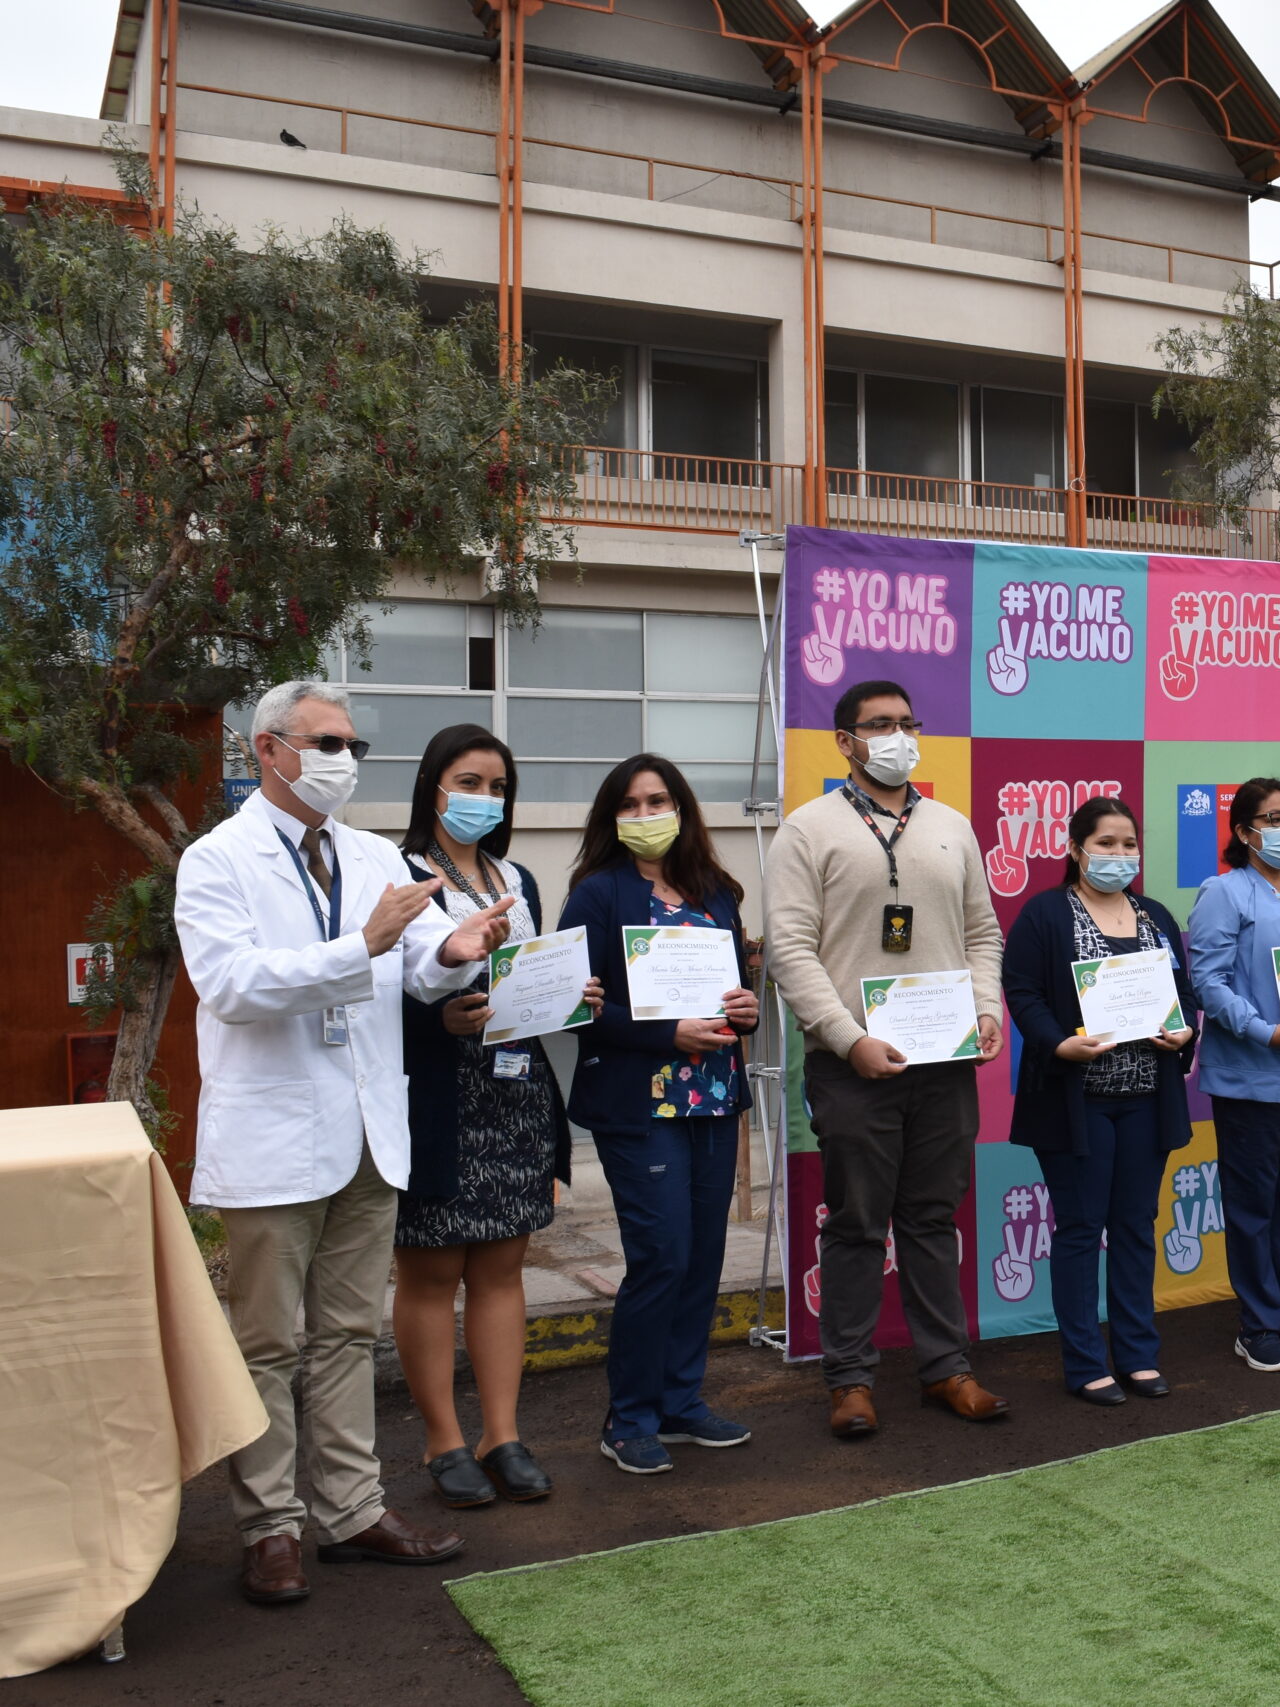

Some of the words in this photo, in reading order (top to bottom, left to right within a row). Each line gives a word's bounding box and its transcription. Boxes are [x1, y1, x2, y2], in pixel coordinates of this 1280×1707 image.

[816, 569, 889, 611] #YO
[899, 576, 949, 614] ME
[1002, 583, 1070, 621] #YO
[1078, 586, 1123, 624] ME
[1174, 594, 1234, 629] #YO
[814, 605, 955, 654] VACUNO
[1001, 619, 1132, 661] VACUNO
[1002, 784, 1068, 820] #YO
[518, 949, 574, 967] RECONOCIMIENTO
[657, 943, 718, 951] RECONOCIMIENTO
[1102, 967, 1155, 979] RECONOCIMIENTO
[893, 988, 954, 999] RECONOCIMIENTO
